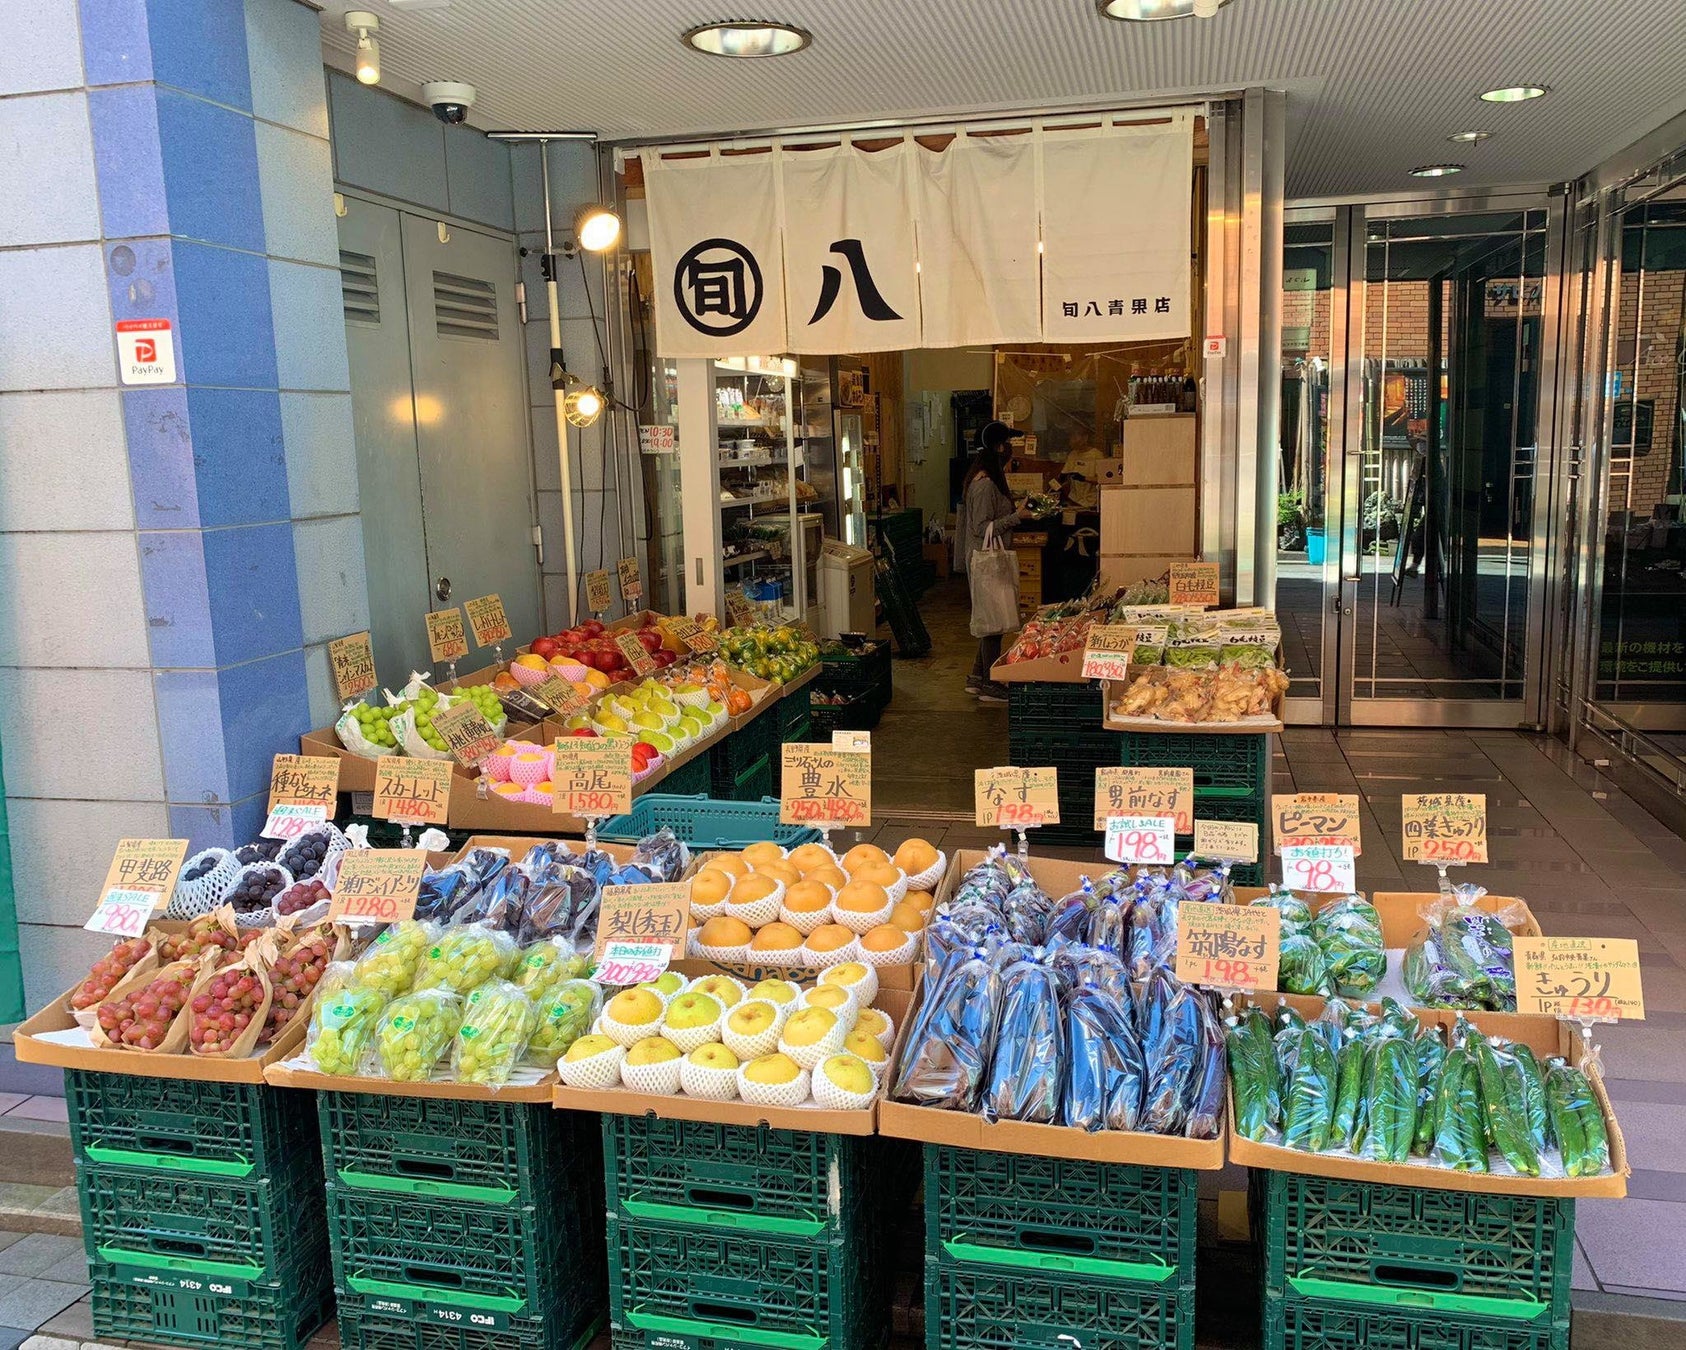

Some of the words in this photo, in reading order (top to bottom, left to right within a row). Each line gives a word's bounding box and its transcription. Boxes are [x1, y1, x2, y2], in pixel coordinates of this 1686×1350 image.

[806, 238, 905, 326] 八
[1062, 296, 1172, 318] 旬八青果店
[131, 365, 164, 376] PayPay
[650, 427, 673, 437] 10:30
[379, 775, 444, 801] スカーレット
[569, 768, 612, 791] 高尾
[798, 767, 853, 798] 豊水
[982, 782, 1032, 807] なす
[1108, 784, 1181, 810] 男前なす
[1280, 811, 1348, 834] ピーマン
[1404, 815, 1485, 839] 四葉きゅうり
[118, 857, 173, 884] 甲斐路
[1185, 928, 1268, 960] 筑陽なす
[1535, 970, 1611, 998] きゅうり
[180, 1279, 203, 1290] 4314
[208, 1284, 232, 1295] IFCO
[439, 1309, 463, 1321] 4314
[469, 1313, 495, 1326] IFCO
